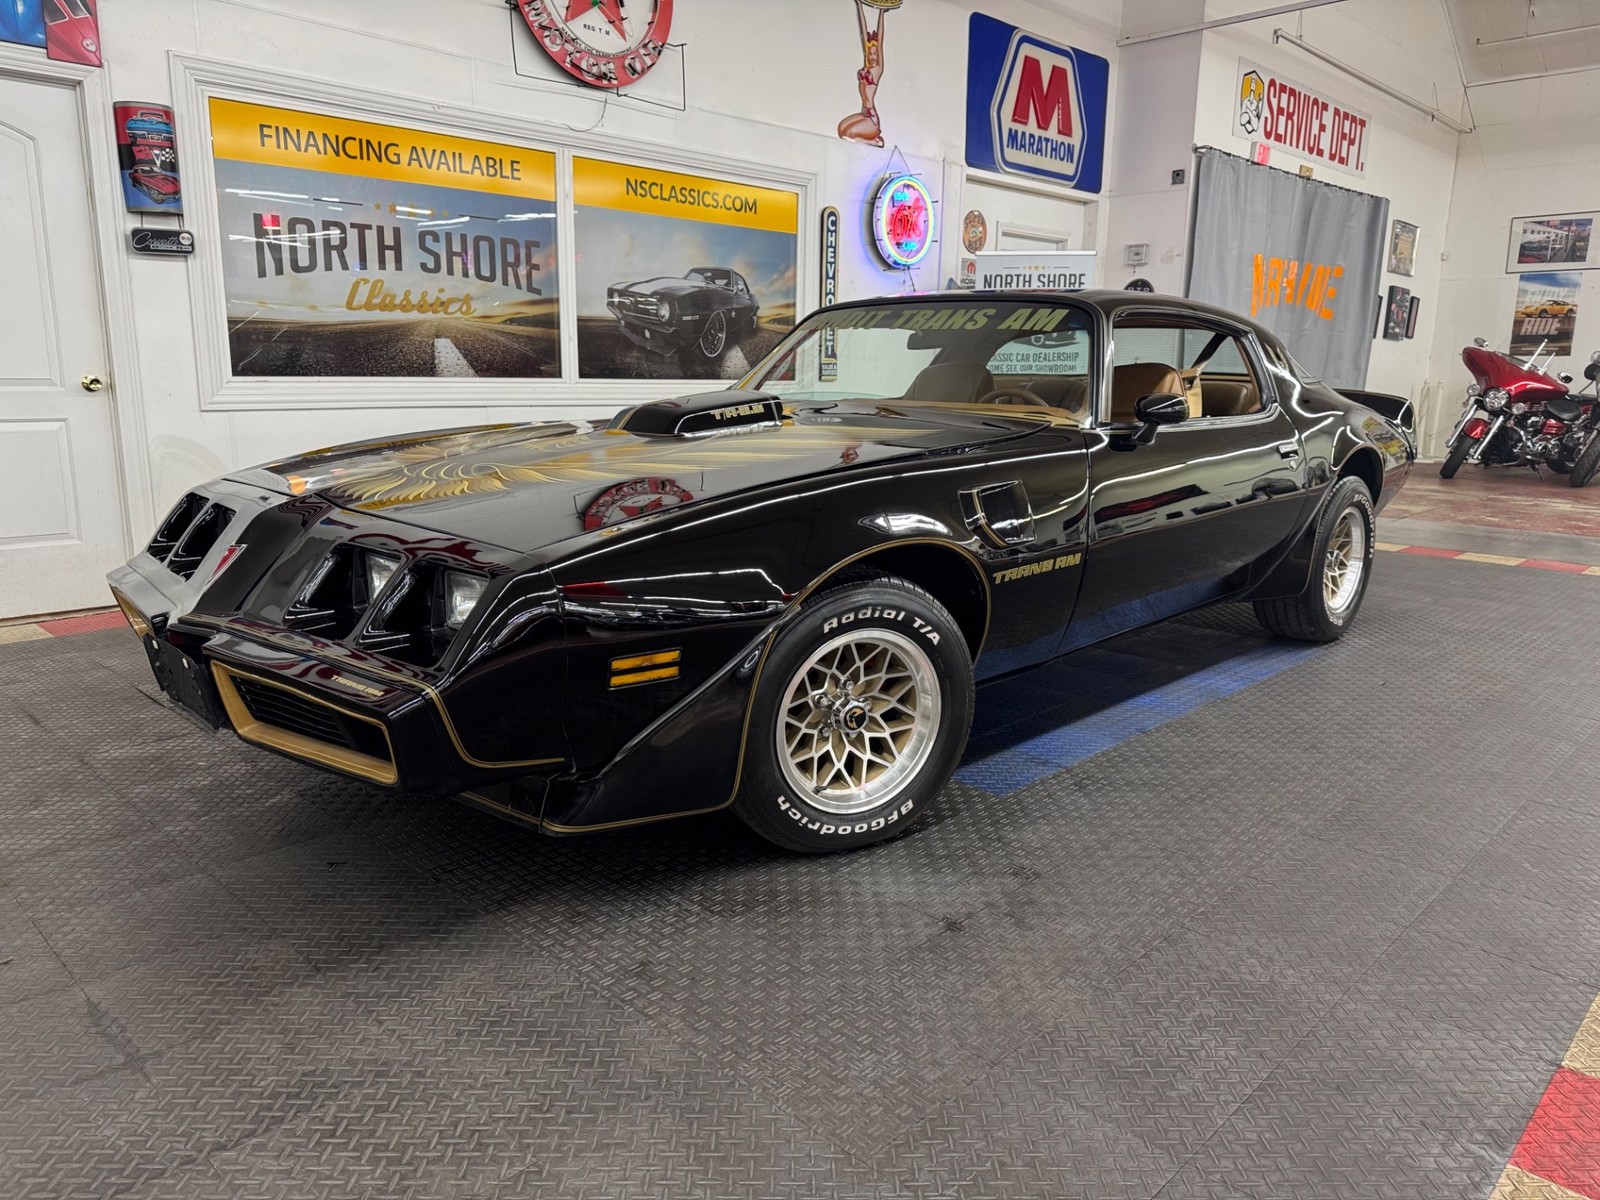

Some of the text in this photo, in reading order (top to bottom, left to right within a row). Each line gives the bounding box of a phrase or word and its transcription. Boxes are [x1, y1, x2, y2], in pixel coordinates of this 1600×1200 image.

[1263, 77, 1367, 172] SERVICE DEPT.
[258, 123, 522, 181] FINANCING AVAILABLE
[1006, 127, 1075, 165] MARATHON
[625, 177, 758, 215] NSCLASSICS.COM
[253, 212, 543, 297] NORTH SHORE
[345, 277, 477, 316] Classics
[824, 215, 837, 355] CHEVROET
[983, 273, 1032, 289] NORTH
[896, 308, 997, 330] TRANS
[997, 308, 1071, 332] AM
[1519, 317, 1563, 336] RIDE
[1006, 364, 1019, 373] SEE
[1020, 364, 1034, 373] OUR
[1016, 353, 1032, 363] CAR
[1032, 351, 1079, 363] DEALERSHIP
[993, 552, 1082, 585] TRANS AM
[823, 606, 941, 646] Radial T/A
[777, 795, 914, 835] BFGoodrich
